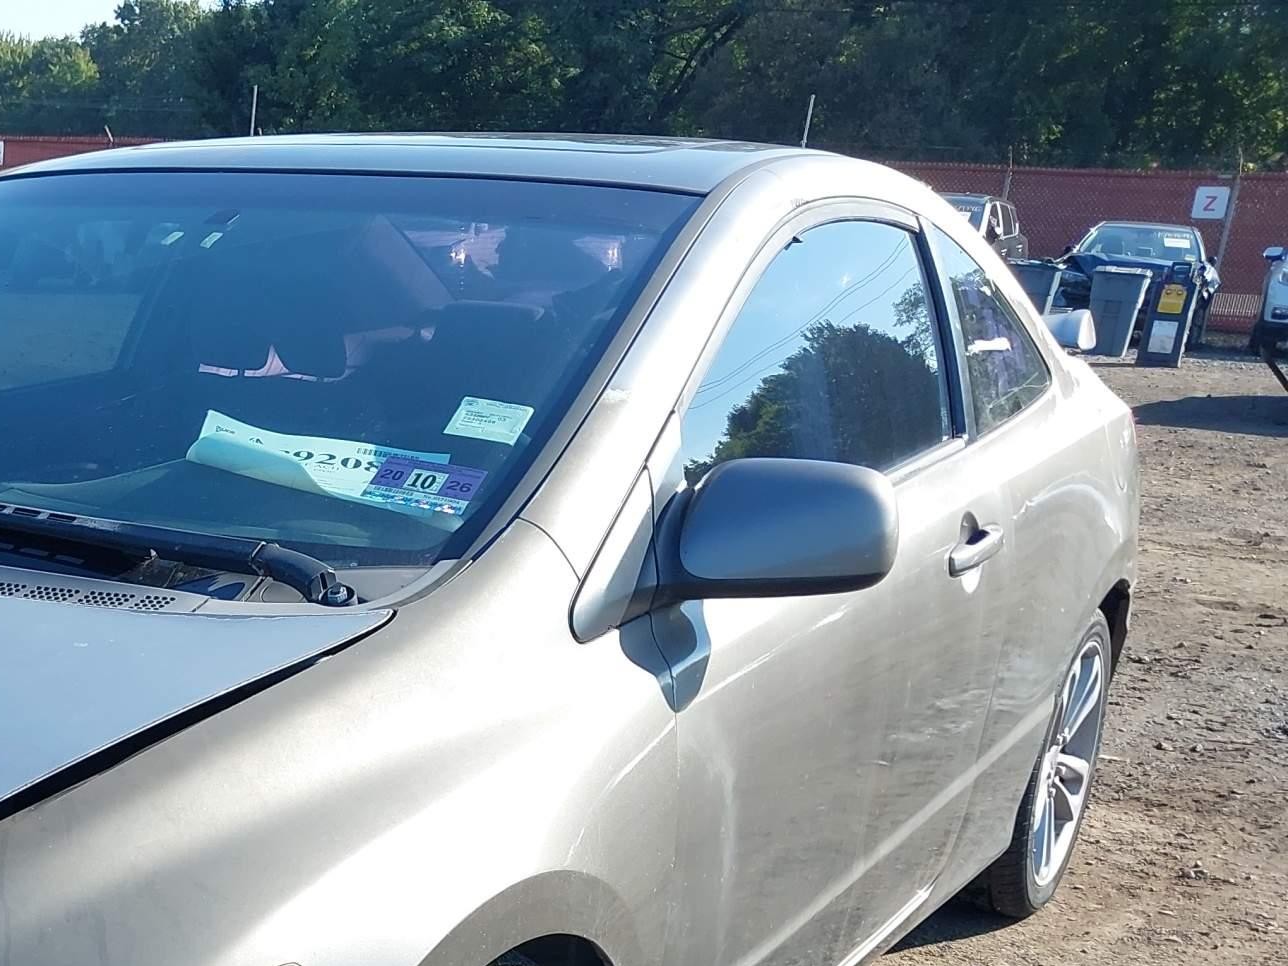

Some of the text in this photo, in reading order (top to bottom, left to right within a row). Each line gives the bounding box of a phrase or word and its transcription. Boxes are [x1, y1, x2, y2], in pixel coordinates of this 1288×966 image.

[1203, 195, 1218, 212] Z
[379, 468, 473, 493] 20 10 26
